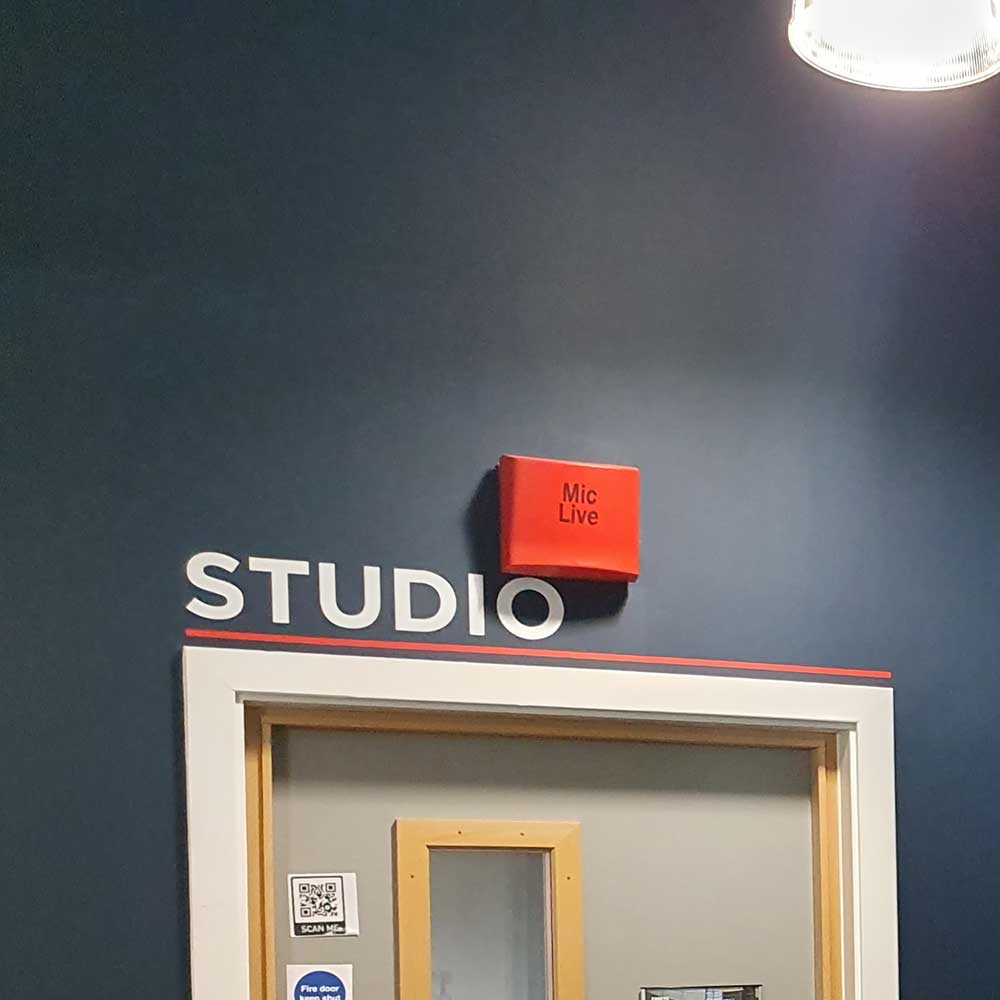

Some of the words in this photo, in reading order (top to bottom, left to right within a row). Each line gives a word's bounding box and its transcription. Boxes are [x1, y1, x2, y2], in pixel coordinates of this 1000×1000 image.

[563, 482, 597, 505] Mic
[559, 503, 599, 526] Live
[185, 551, 565, 641] STUDIO
[300, 924, 325, 934] SCAN
[300, 985, 318, 993] Fire
[319, 985, 340, 993] door
